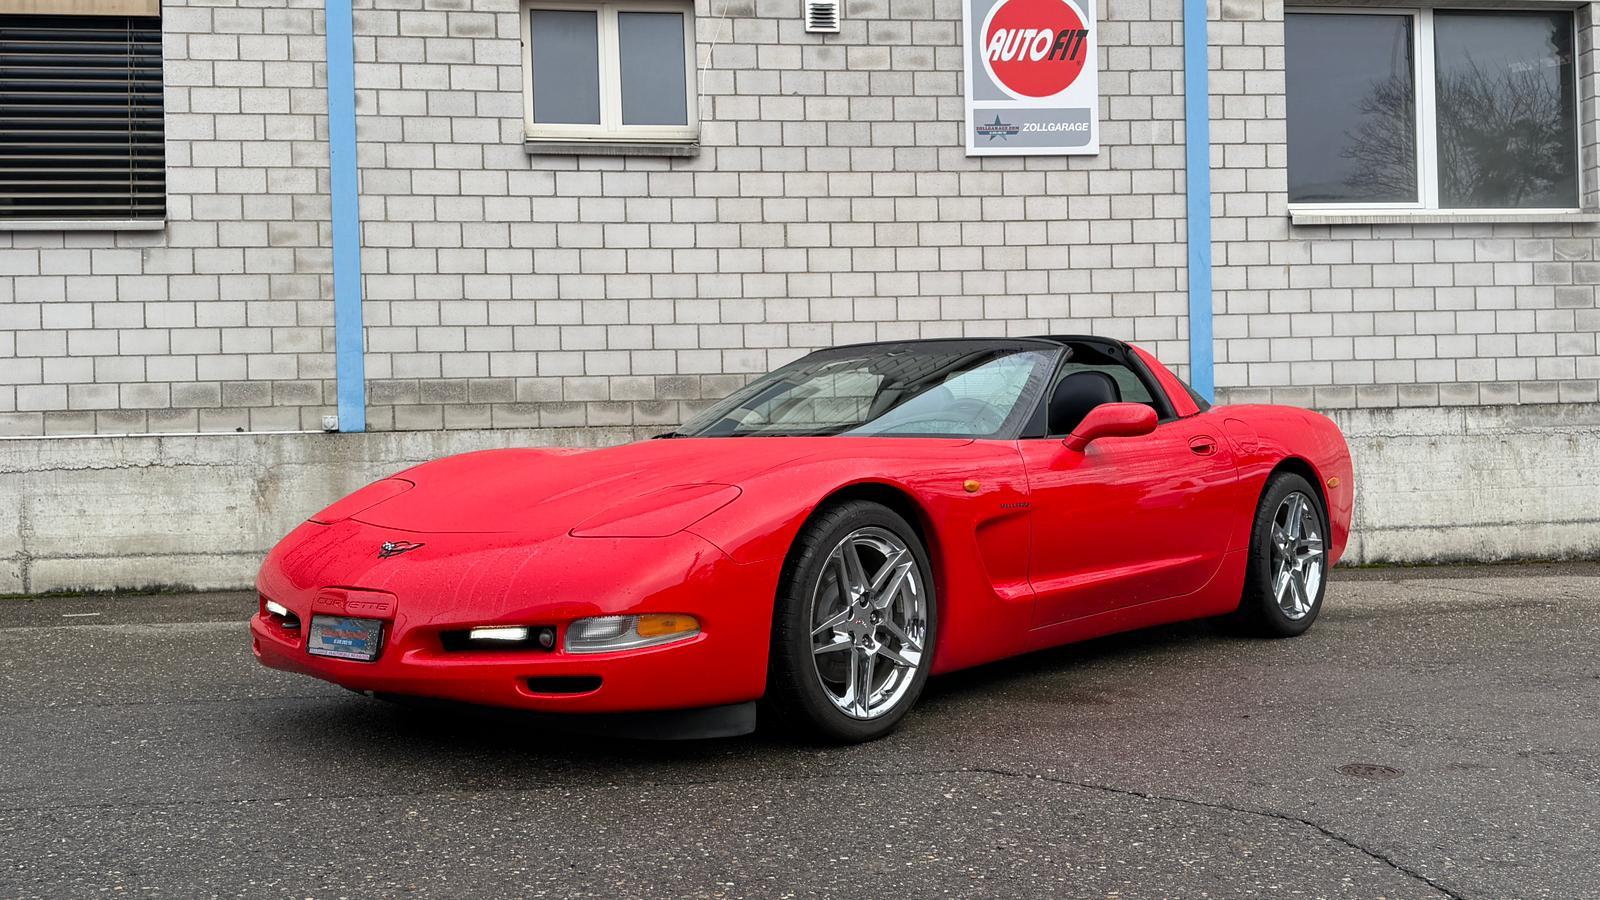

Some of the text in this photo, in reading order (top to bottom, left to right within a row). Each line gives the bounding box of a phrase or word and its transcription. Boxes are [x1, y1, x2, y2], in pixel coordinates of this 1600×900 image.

[987, 28, 1090, 62] AUTOFIT
[1022, 122, 1089, 132] ZOLLGARAGE
[317, 597, 389, 611] CORVETTE
